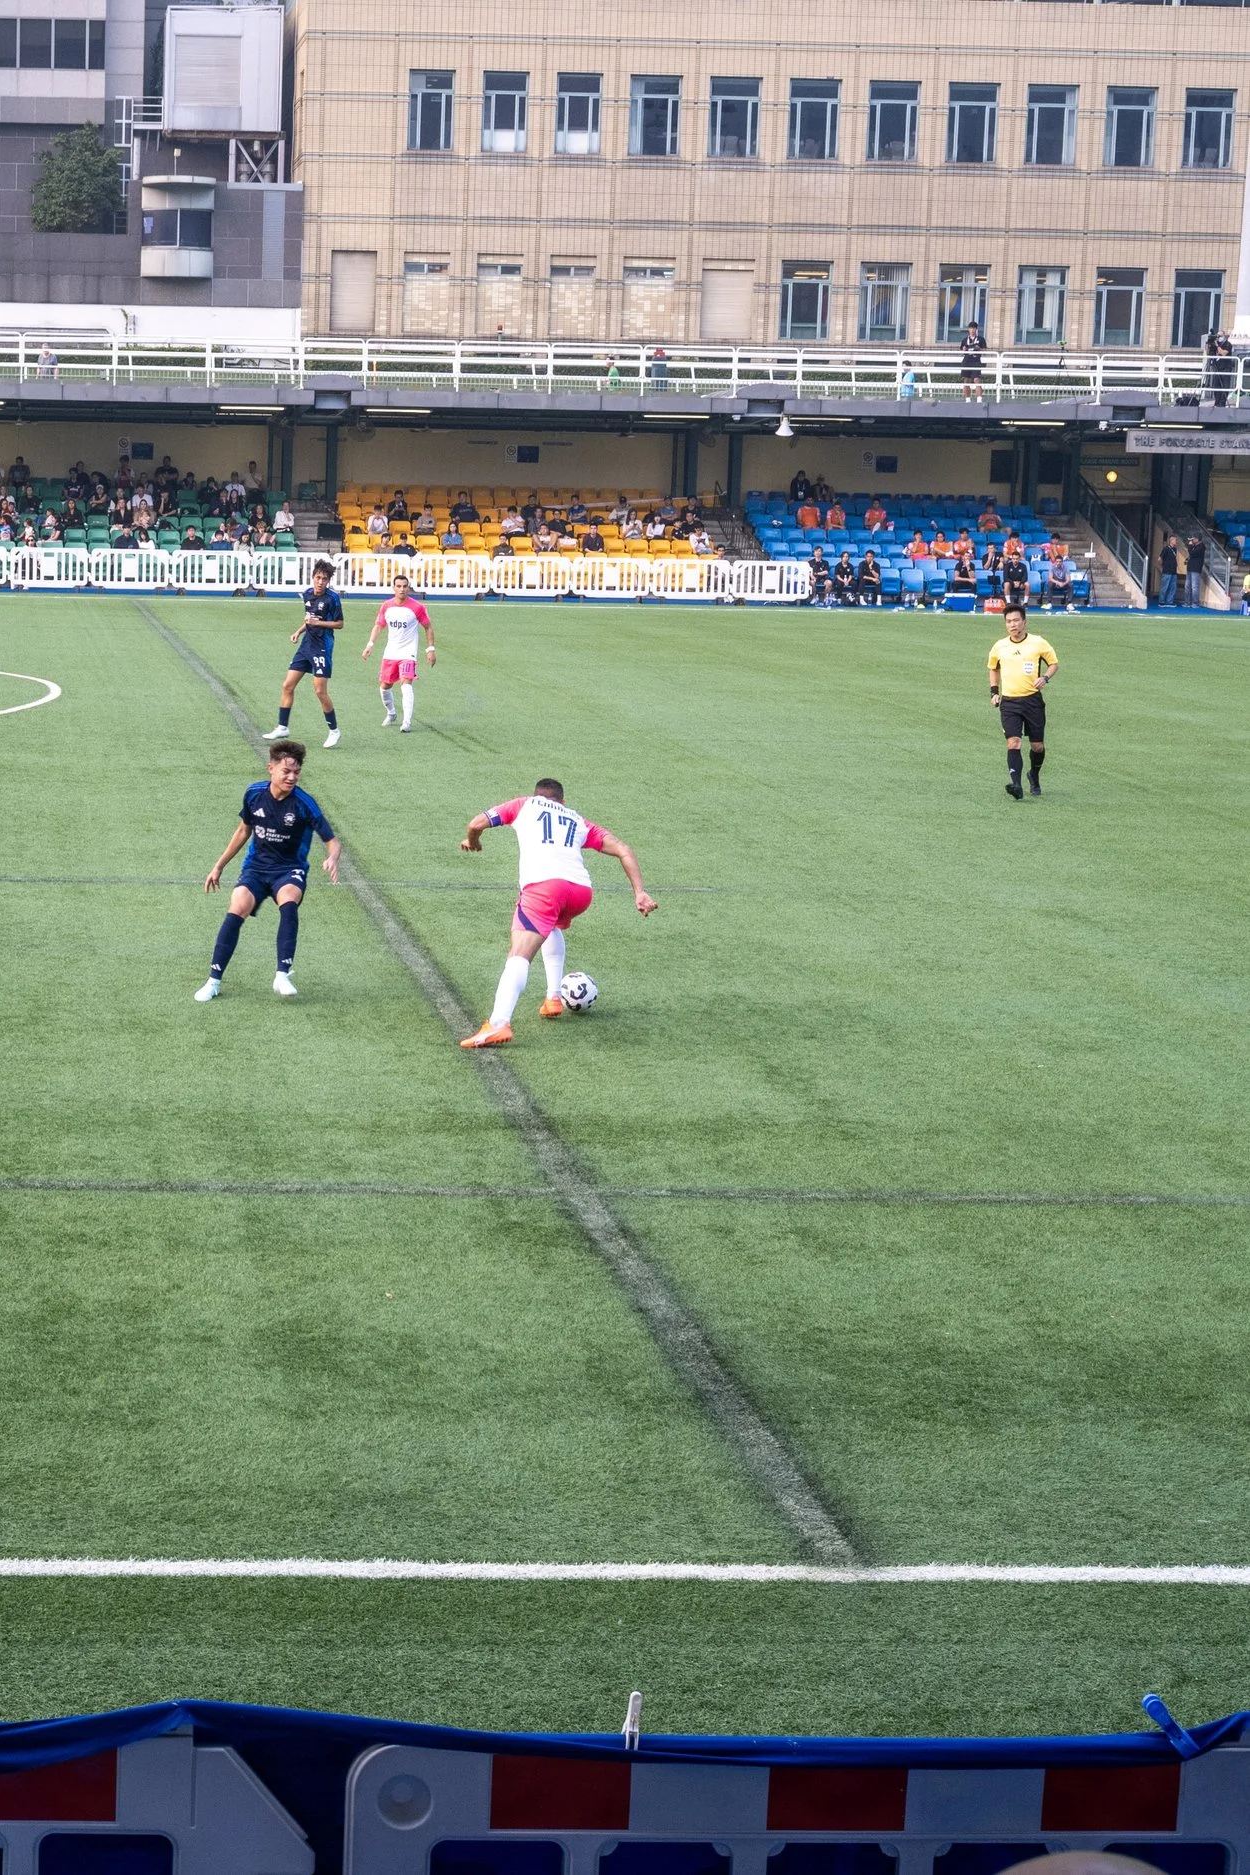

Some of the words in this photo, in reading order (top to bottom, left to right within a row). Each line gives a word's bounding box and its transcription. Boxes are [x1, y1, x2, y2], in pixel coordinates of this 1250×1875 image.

[1134, 436, 1155, 448] THE
[389, 619, 408, 630] edps
[312, 656, 326, 668] 99
[536, 810, 578, 848] 17
